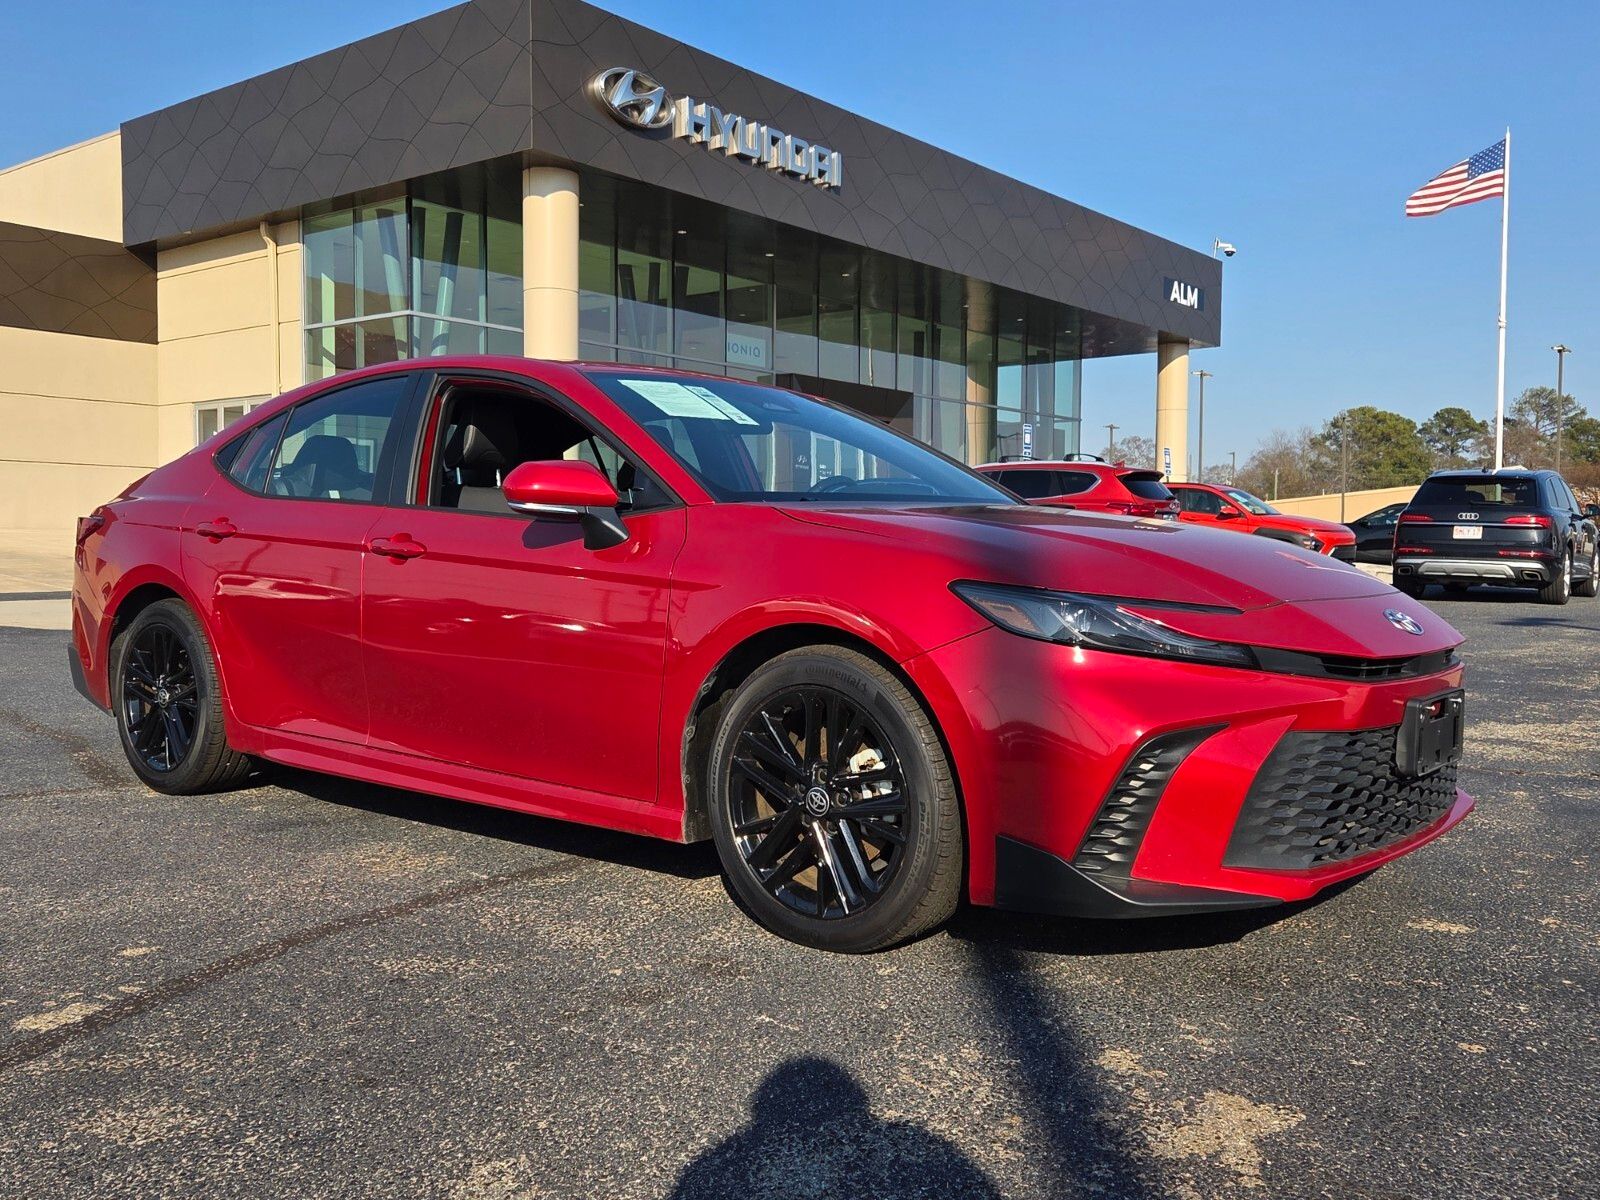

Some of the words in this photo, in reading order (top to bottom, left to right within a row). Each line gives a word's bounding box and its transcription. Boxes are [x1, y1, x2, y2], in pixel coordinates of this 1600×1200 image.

[673, 95, 842, 188] HYUNDAI
[1169, 280, 1199, 309] ALM
[727, 342, 761, 358] IONIQ
